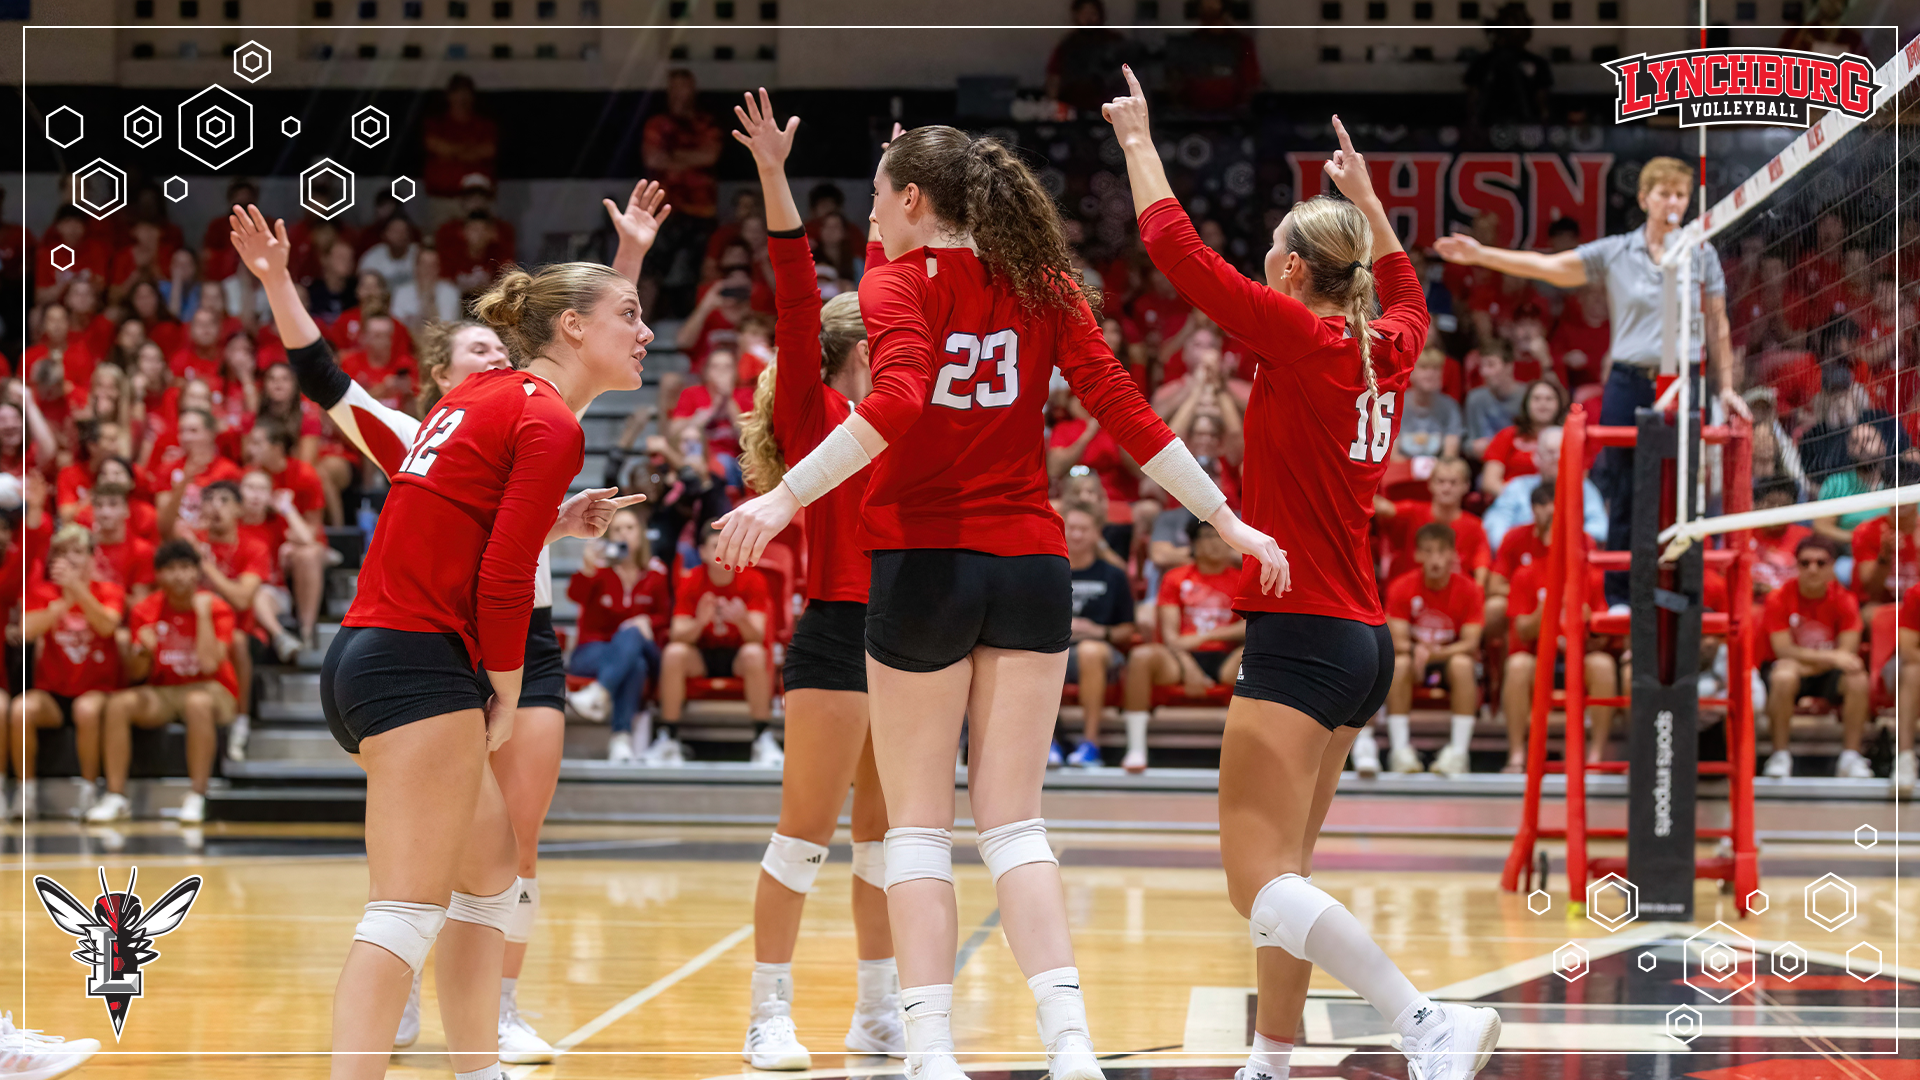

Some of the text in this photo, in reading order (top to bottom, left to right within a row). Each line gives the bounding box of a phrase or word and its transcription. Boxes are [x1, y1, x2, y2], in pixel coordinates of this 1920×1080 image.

[930, 327, 1019, 410] 23
[398, 406, 466, 477] 12
[1349, 387, 1397, 464] 16
